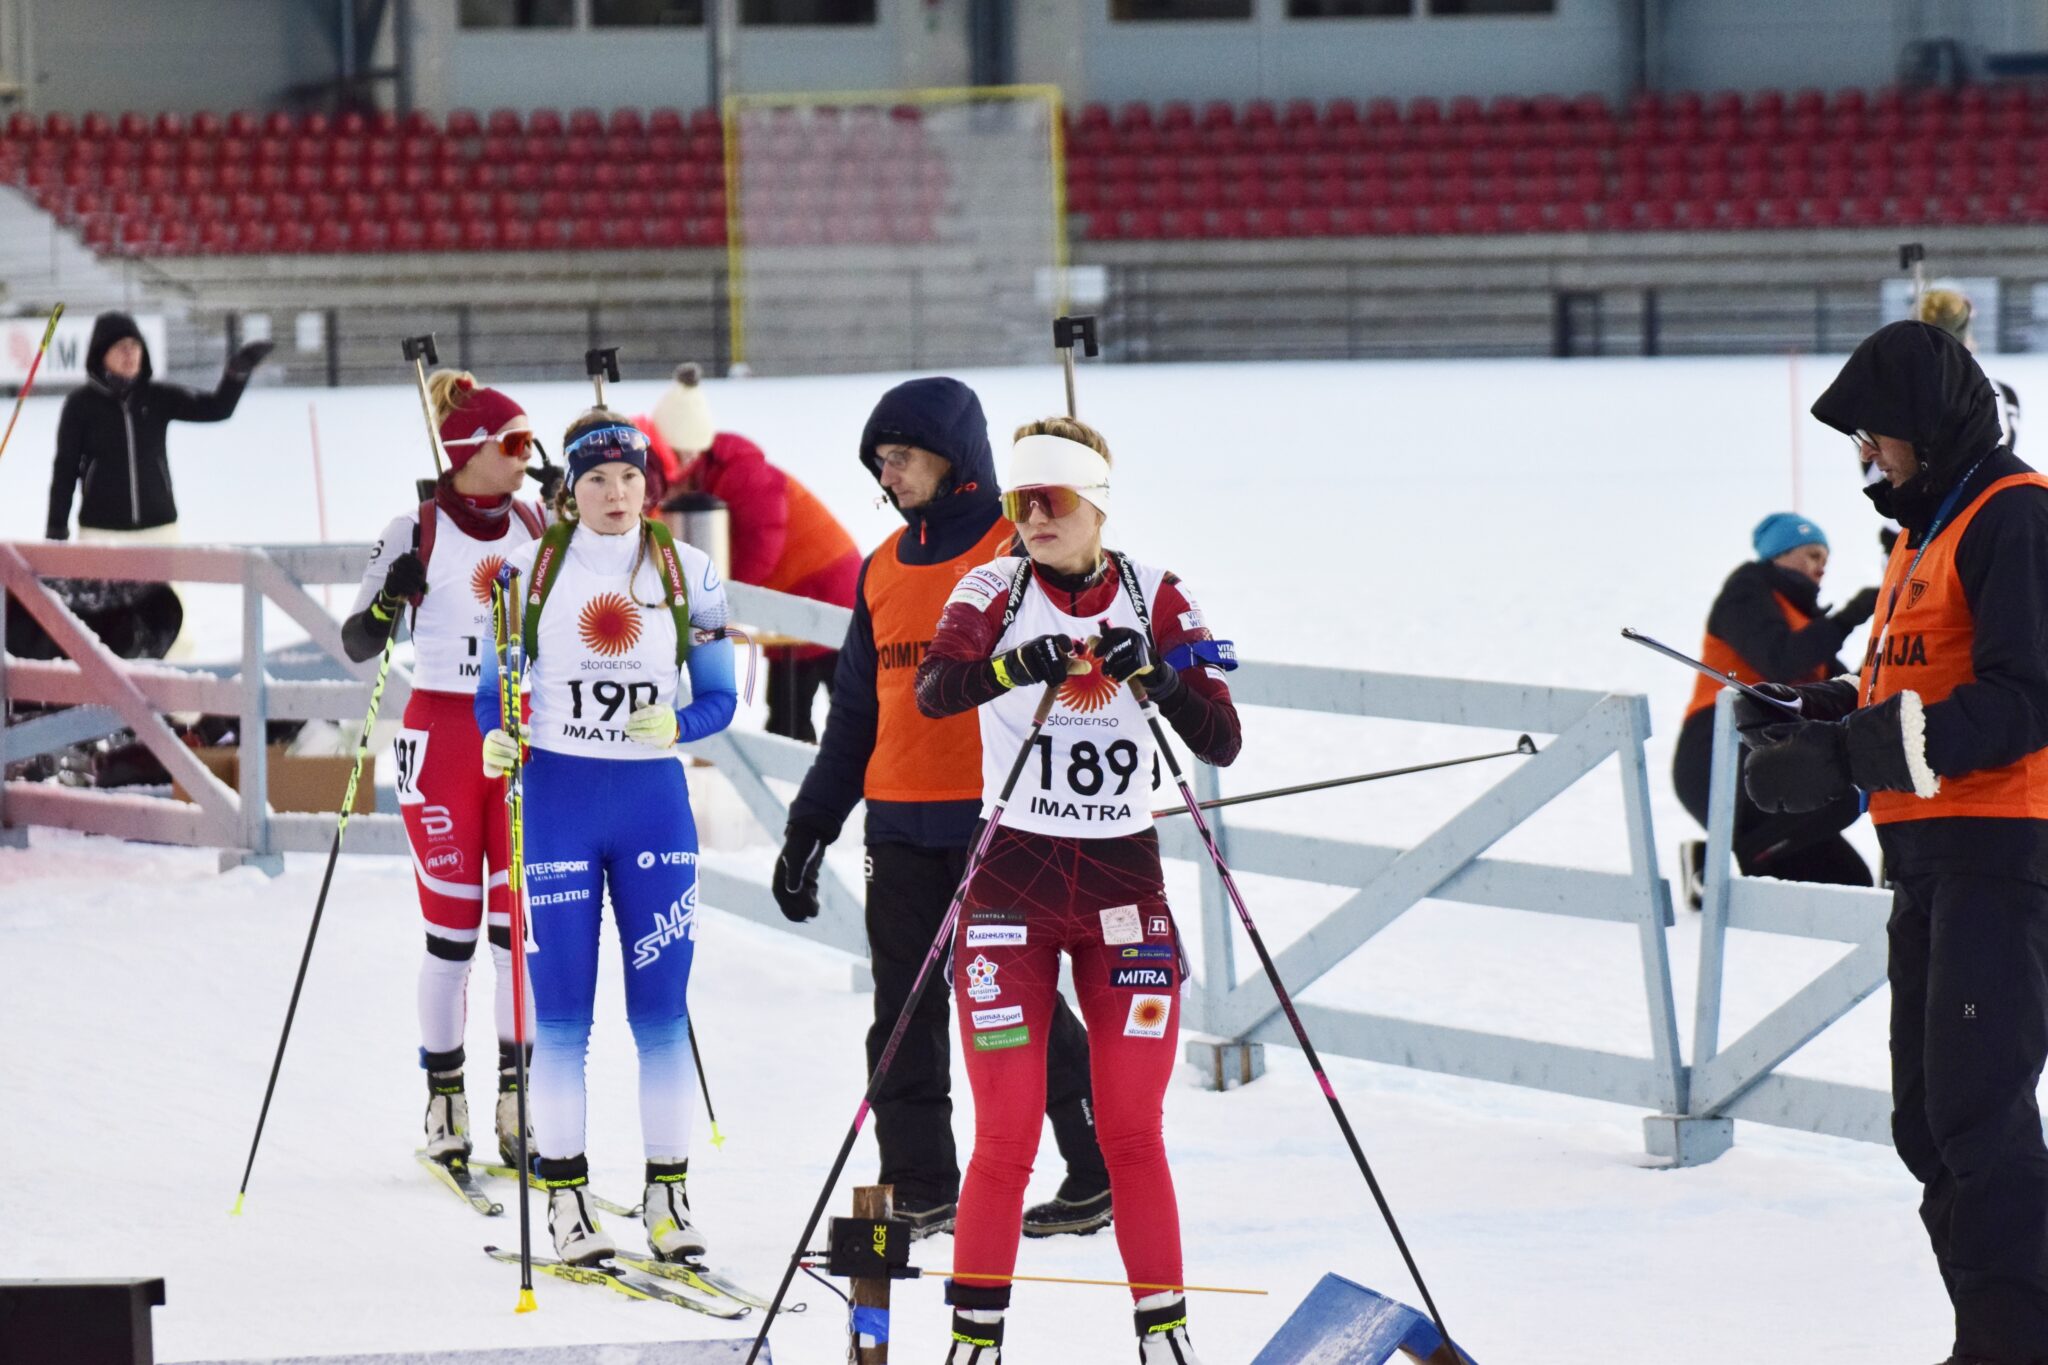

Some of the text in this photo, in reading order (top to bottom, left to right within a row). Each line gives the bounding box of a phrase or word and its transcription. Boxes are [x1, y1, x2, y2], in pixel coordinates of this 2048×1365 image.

[1033, 733, 1138, 797] 189
[1030, 796, 1132, 822] IMATRA
[660, 851, 697, 865] VERT
[525, 860, 589, 877] NTERSPORT
[529, 889, 590, 906] oname
[1117, 969, 1168, 985] MITRA
[872, 1224, 887, 1257] ALGE
